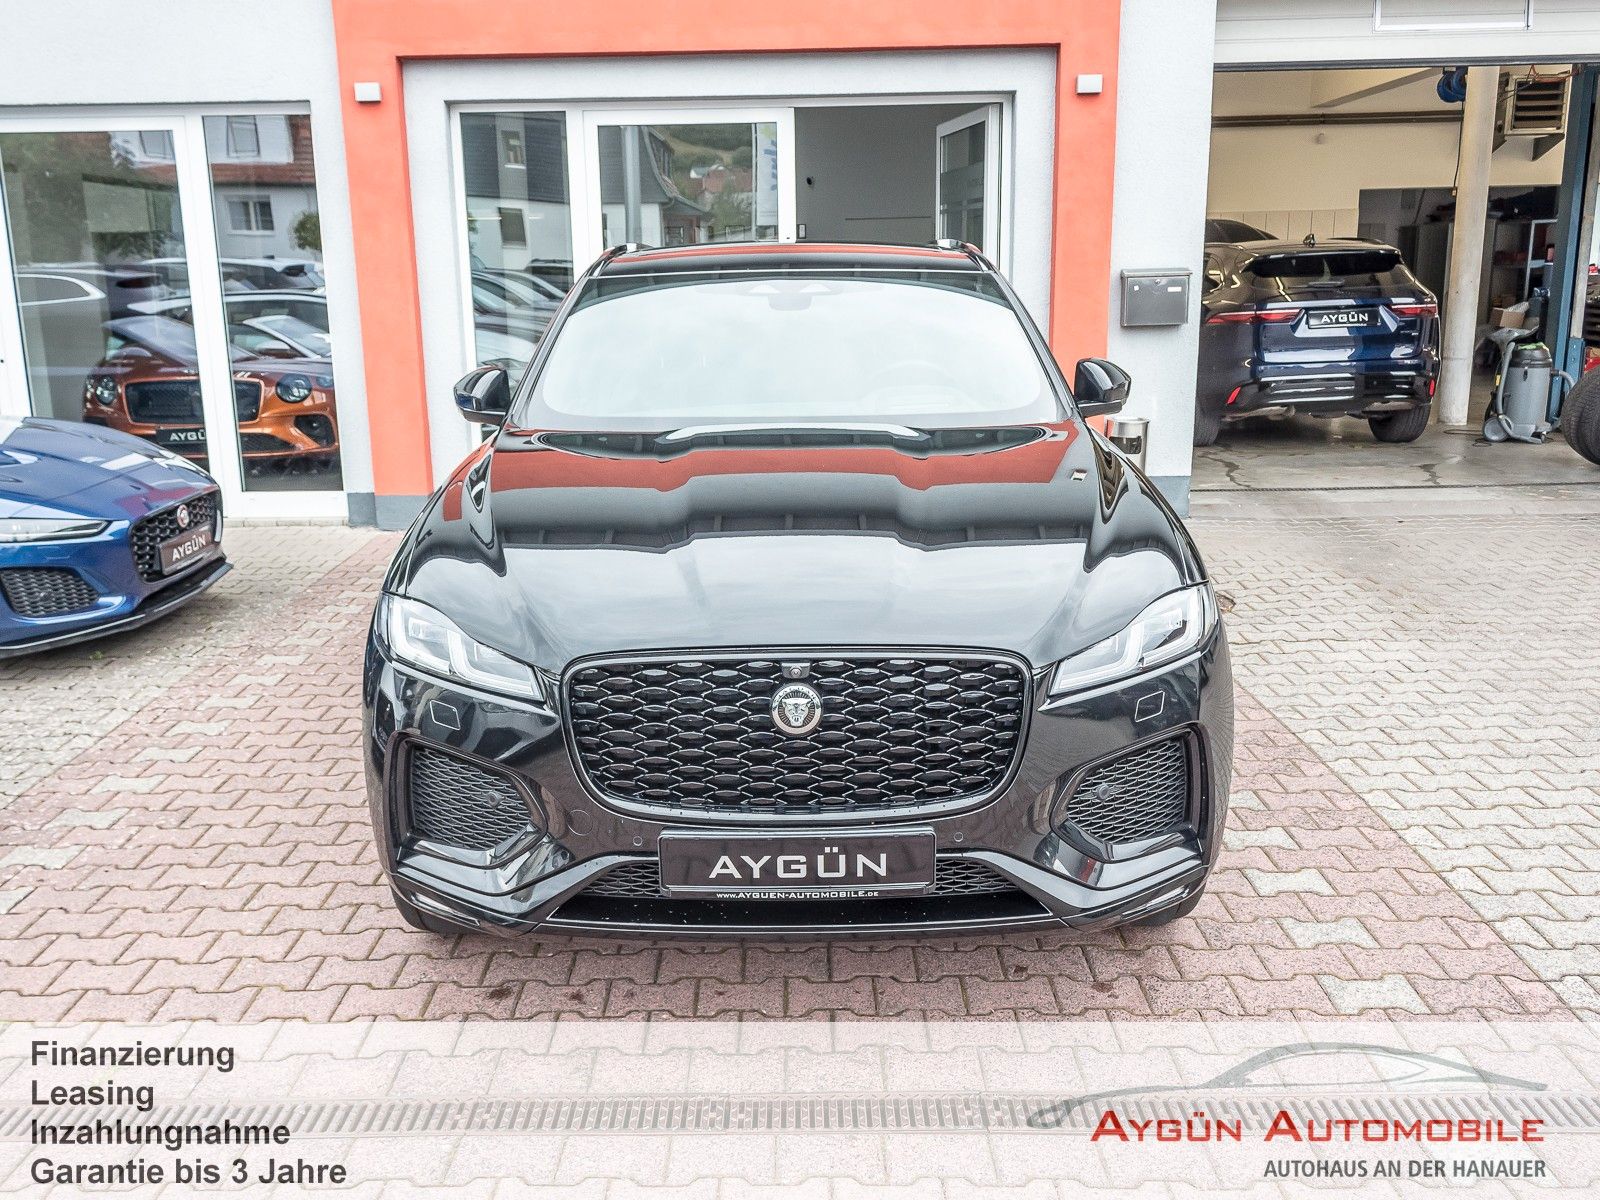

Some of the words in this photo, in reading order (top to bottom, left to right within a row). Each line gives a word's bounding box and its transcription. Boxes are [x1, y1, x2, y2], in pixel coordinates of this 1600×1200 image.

[1321, 312, 1369, 322] AYGÜN
[170, 429, 206, 441] AYGÜ
[172, 534, 206, 561] AYGÜN
[708, 846, 887, 879] AYGÜN
